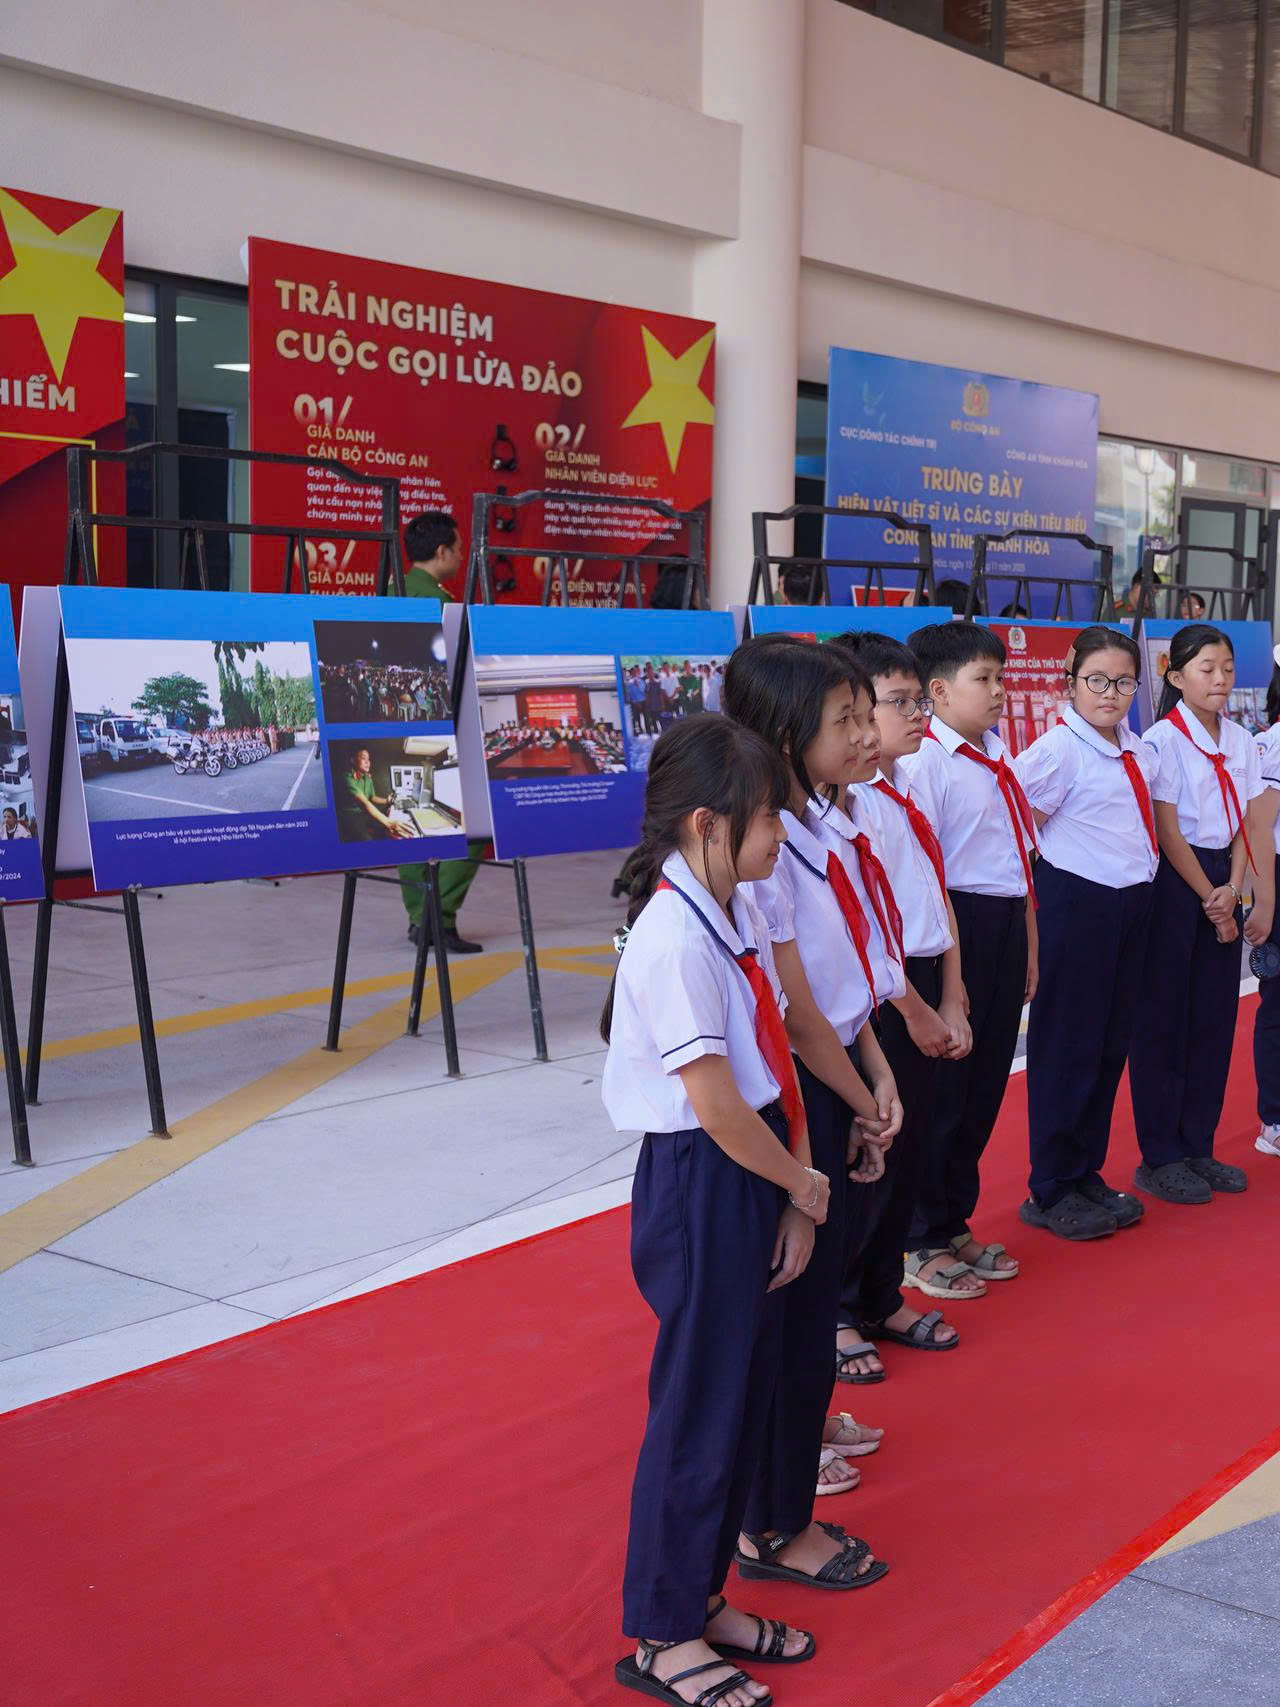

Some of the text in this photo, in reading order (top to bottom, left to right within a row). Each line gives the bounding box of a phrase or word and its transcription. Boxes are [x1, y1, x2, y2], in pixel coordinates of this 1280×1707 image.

[274, 280, 493, 346] TRẢI NGHIỆM
[275, 329, 583, 397] CUỘC GỌI LỪA ĐẢO
[293, 393, 353, 425] 01/
[335, 427, 376, 444] DANH
[840, 426, 858, 439] CỤC
[859, 428, 883, 443] CÔNG
[885, 431, 899, 445] TÁC
[901, 434, 925, 448] CHÍNH
[307, 443, 428, 468] CÁN BỘ CÔNG AN
[568, 452, 600, 466] DANH
[307, 466, 324, 480] Gọi
[545, 466, 579, 482] NHÂN
[581, 469, 607, 485] VIÊN
[608, 472, 635, 489] ĐIỆN
[921, 465, 1024, 499] TRƯNG BÀY
[307, 483, 331, 493] quan
[333, 482, 351, 494] đến
[353, 487, 364, 498] vụ
[307, 495, 324, 507] yêu
[345, 500, 363, 511] nạn
[307, 508, 337, 522] chứng
[340, 512, 363, 521] minh
[943, 502, 961, 522] VÀ
[963, 504, 992, 526] CÁC
[994, 509, 1010, 530] SỰ
[1025, 535, 1050, 556] HÒA
[335, 572, 375, 586] DANH
[1009, 658, 1027, 669] KHEN
[1027, 656, 1041, 669] CỦA
[1042, 656, 1055, 669] THỦ
[143, 831, 158, 839] Công
